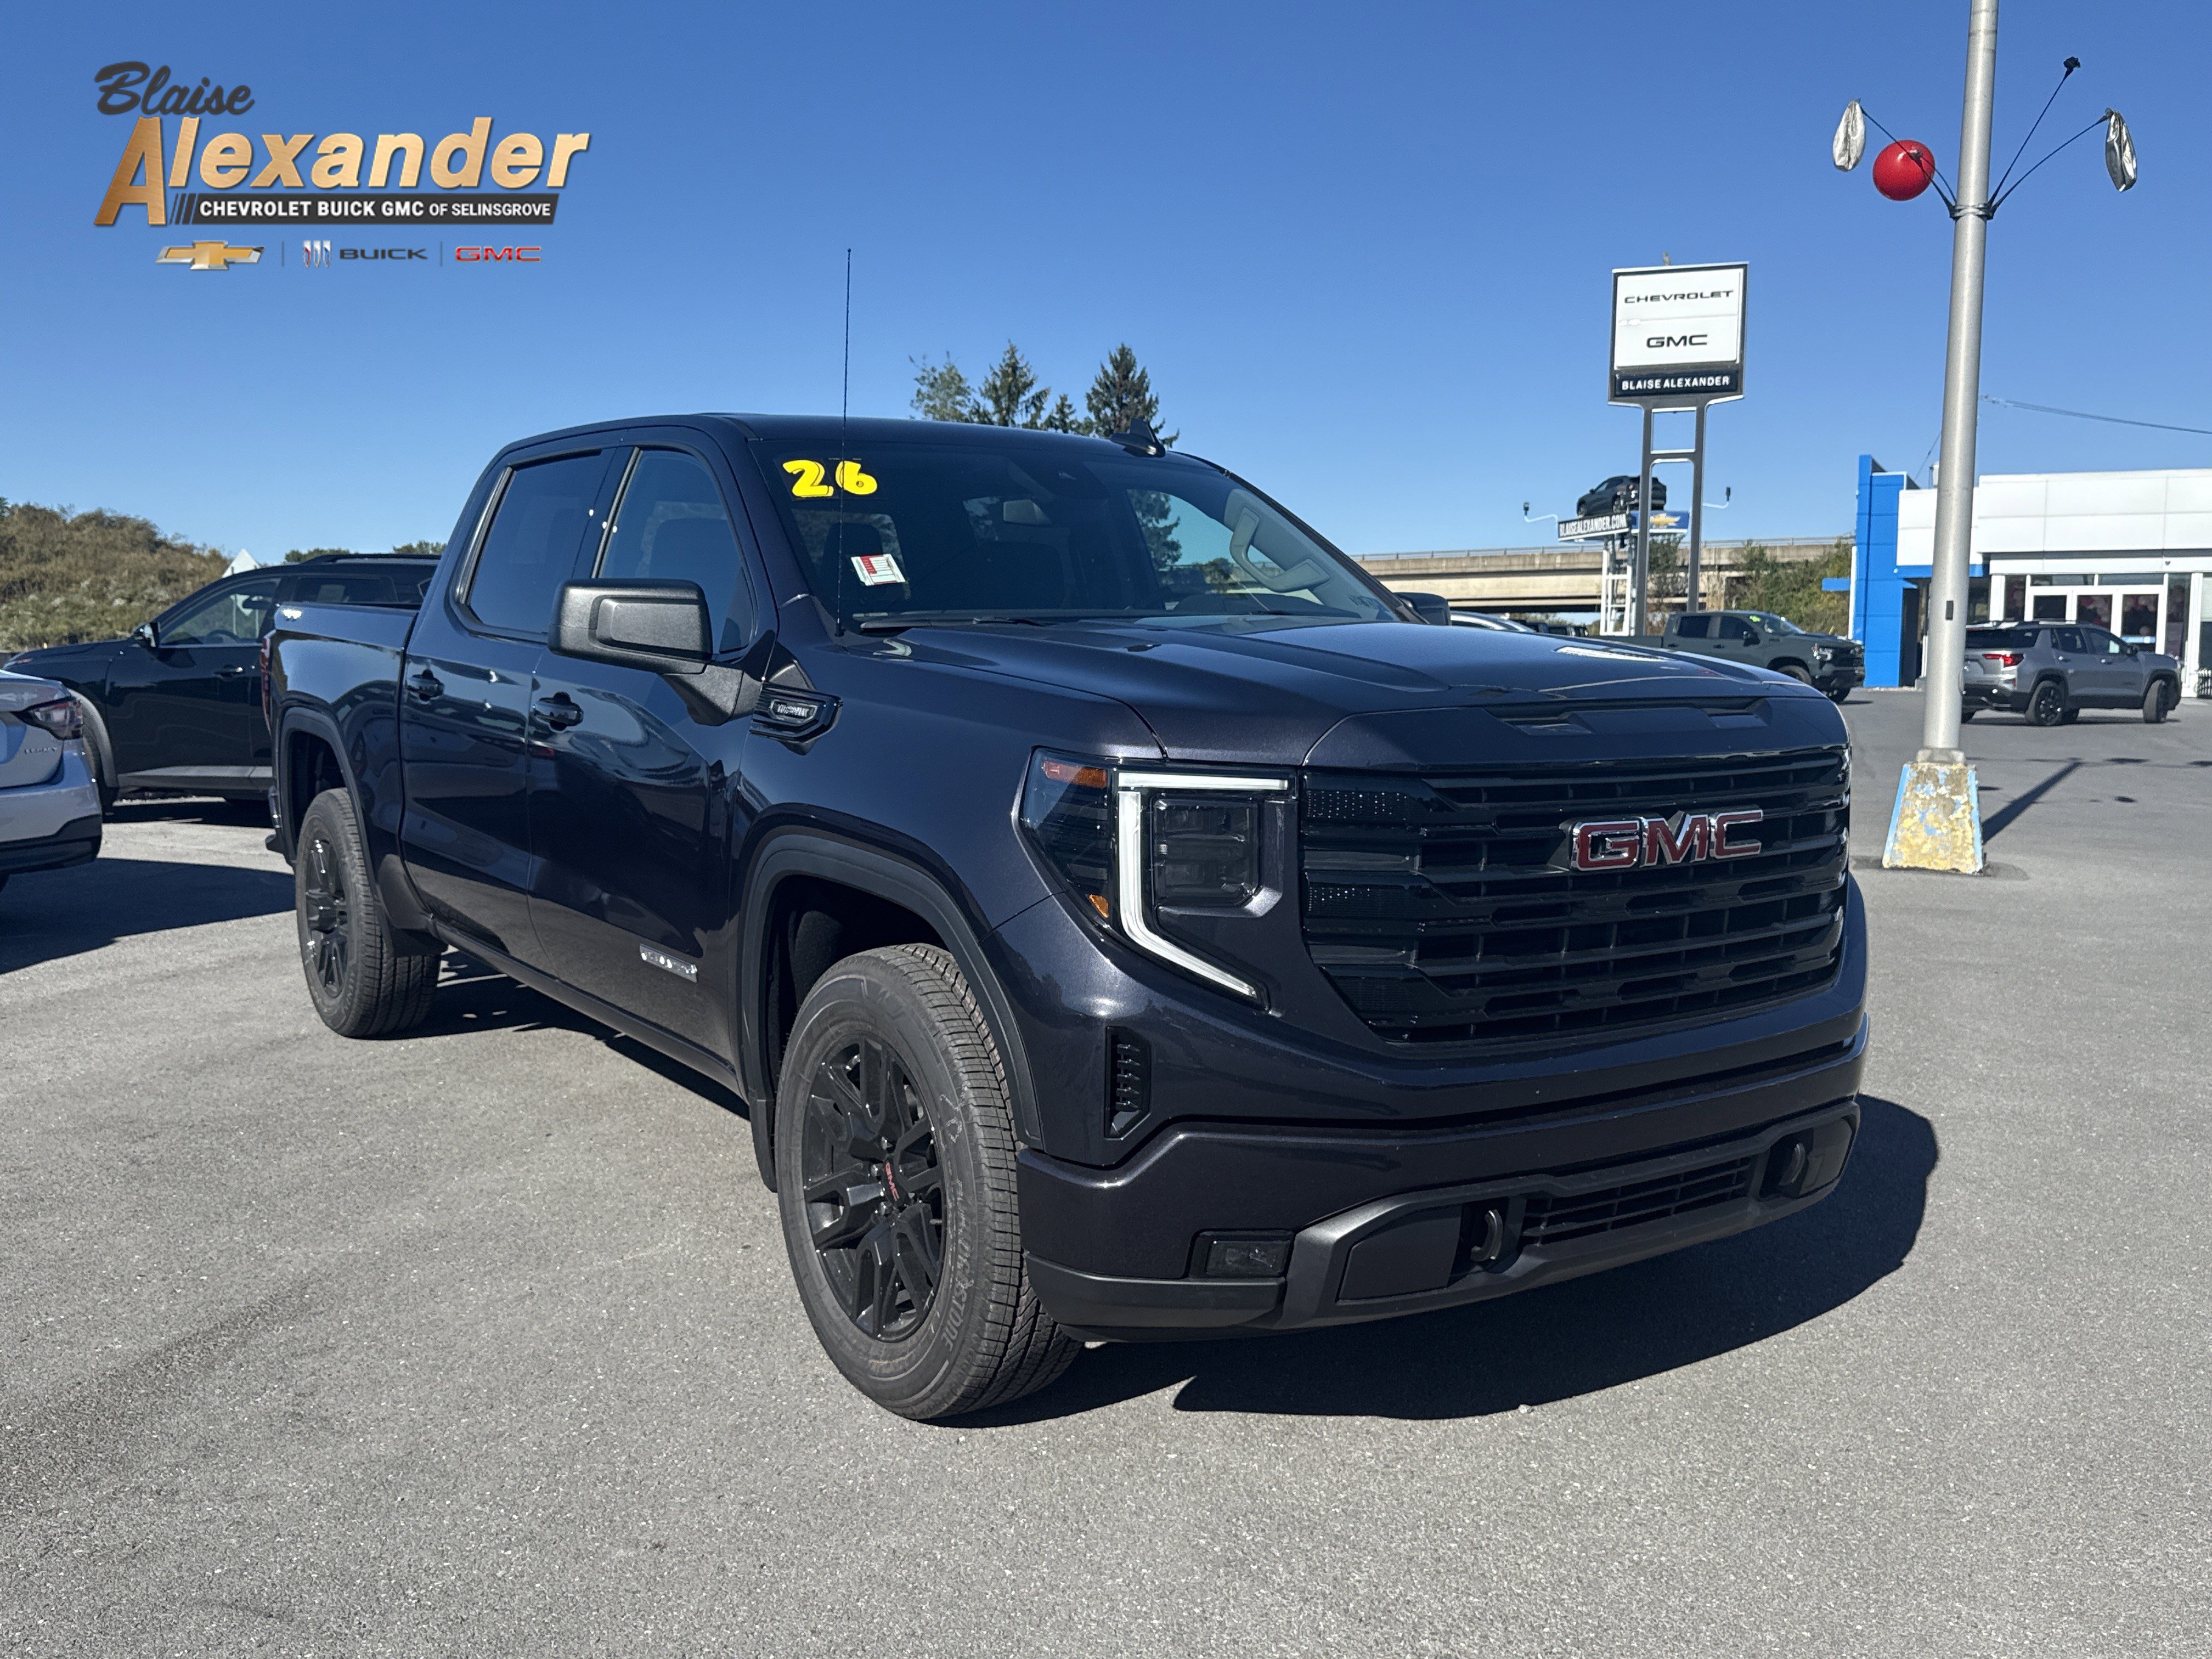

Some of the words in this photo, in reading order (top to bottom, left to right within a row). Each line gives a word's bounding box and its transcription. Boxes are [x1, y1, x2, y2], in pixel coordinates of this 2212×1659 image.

[1624, 290, 1734, 304] CHEVROLET
[1646, 333, 1708, 349] GMC
[1621, 379, 1662, 391] BLAISE
[1663, 375, 1730, 390] ALEXANDER
[783, 459, 877, 497] 26
[1571, 809, 1764, 871] GMC
[885, 1162, 900, 1201] GMC
